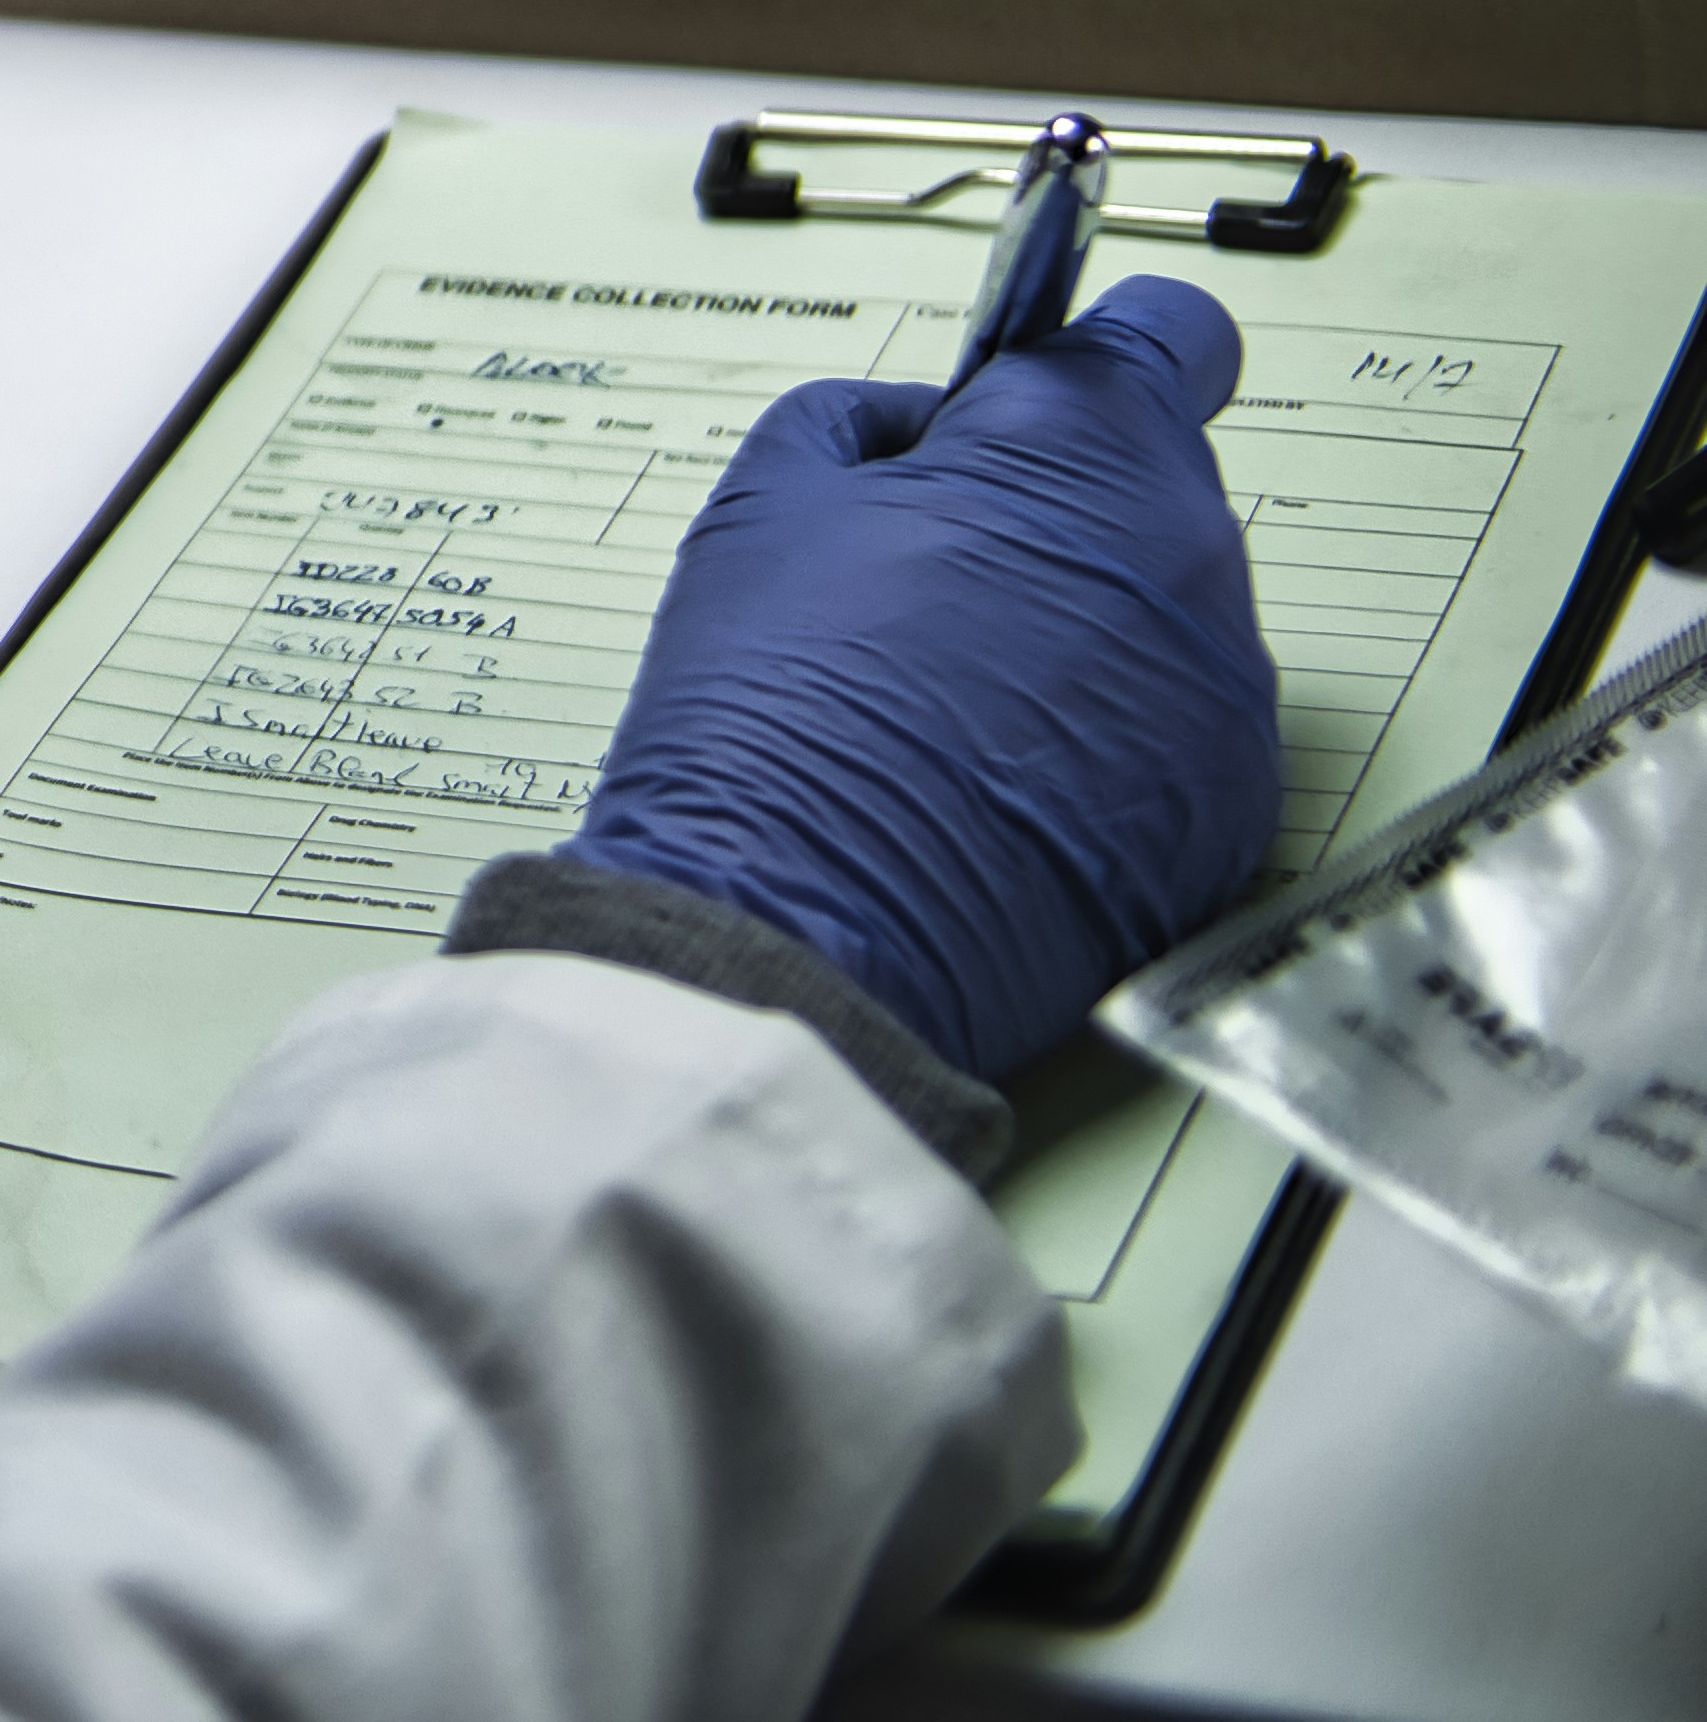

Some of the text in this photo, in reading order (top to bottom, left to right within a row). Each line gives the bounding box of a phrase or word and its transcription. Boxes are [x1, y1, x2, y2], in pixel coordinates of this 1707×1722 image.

[418, 274, 858, 320] EVIDENCE COLLECTION FORM
